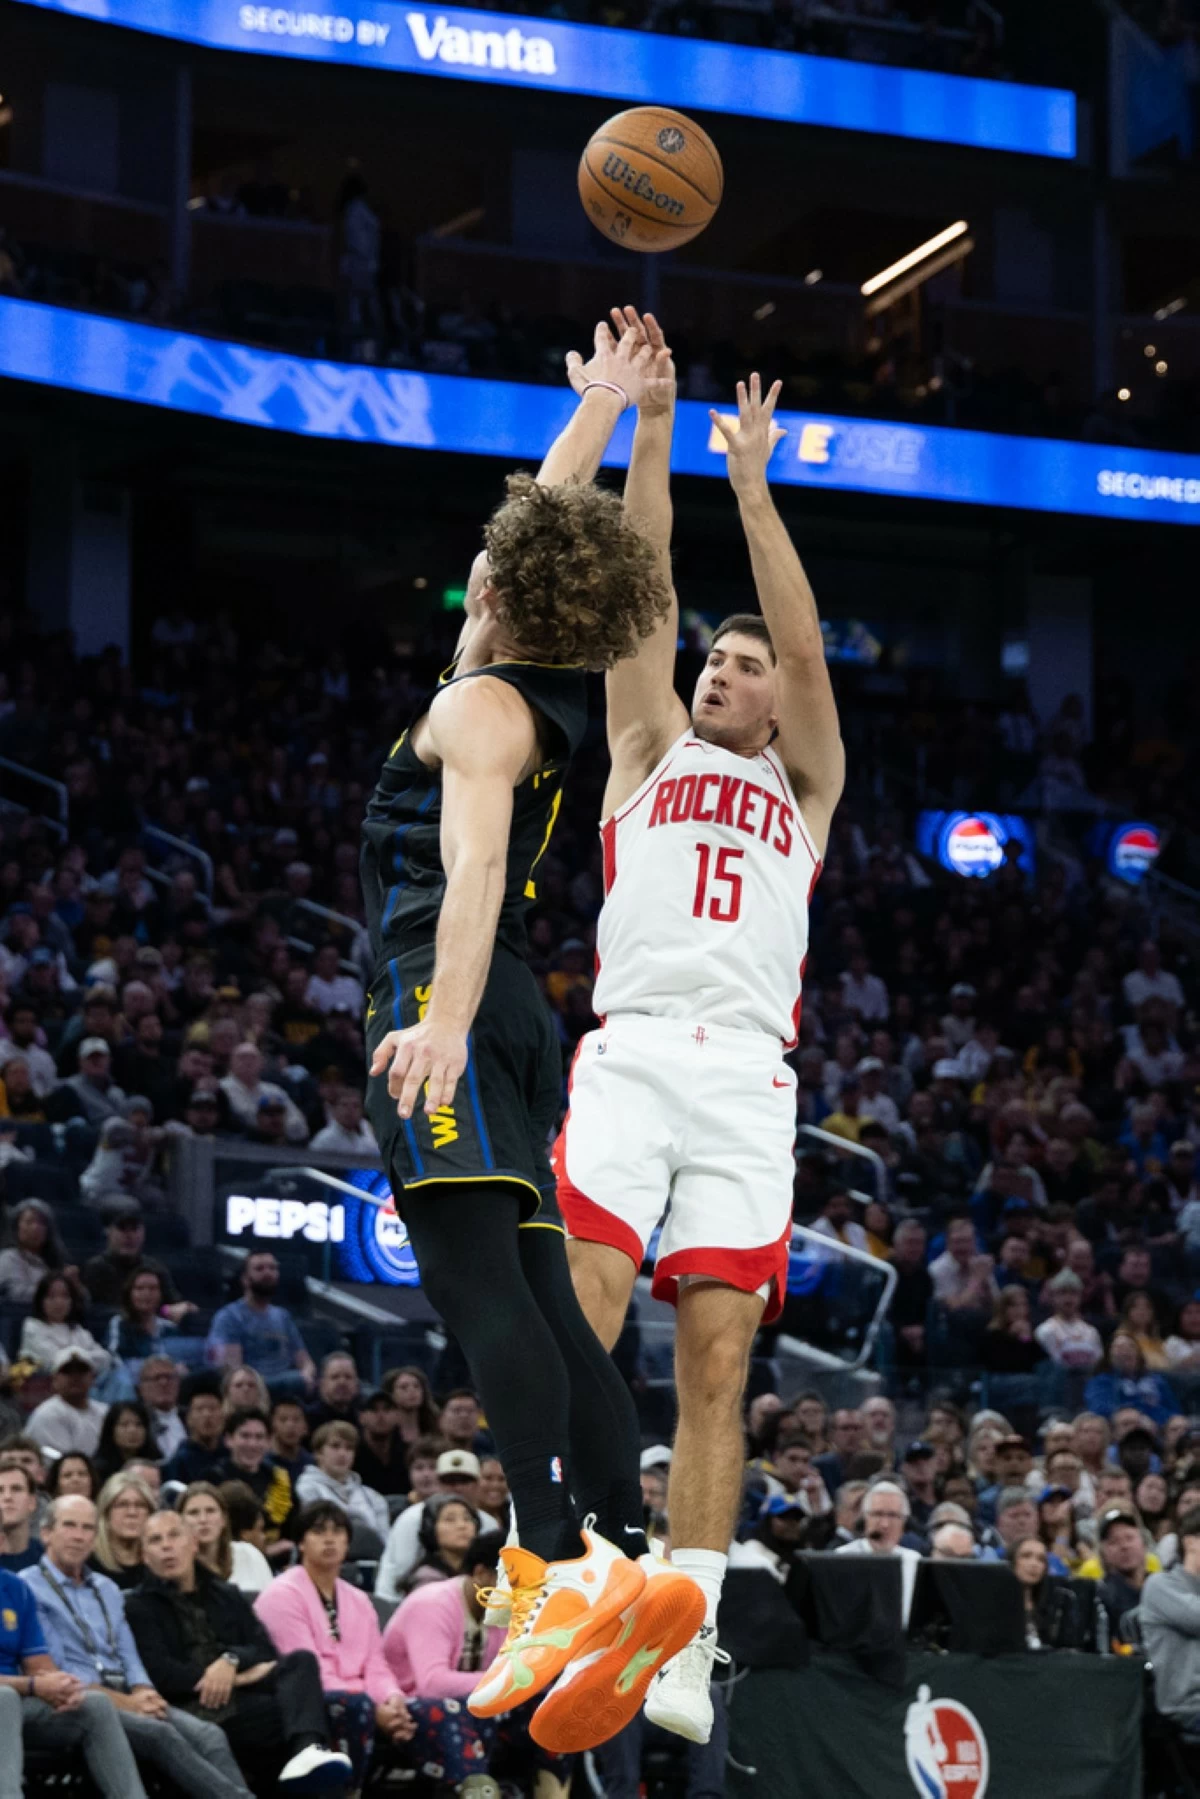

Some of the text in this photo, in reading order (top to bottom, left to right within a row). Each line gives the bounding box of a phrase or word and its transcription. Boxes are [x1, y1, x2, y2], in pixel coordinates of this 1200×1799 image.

[239, 6, 557, 75] SECURED BY Vanta
[602, 151, 685, 217] Wilson
[647, 772, 795, 858] ROCKETS
[692, 841, 745, 923] 15
[226, 1194, 346, 1243] PEPSI
